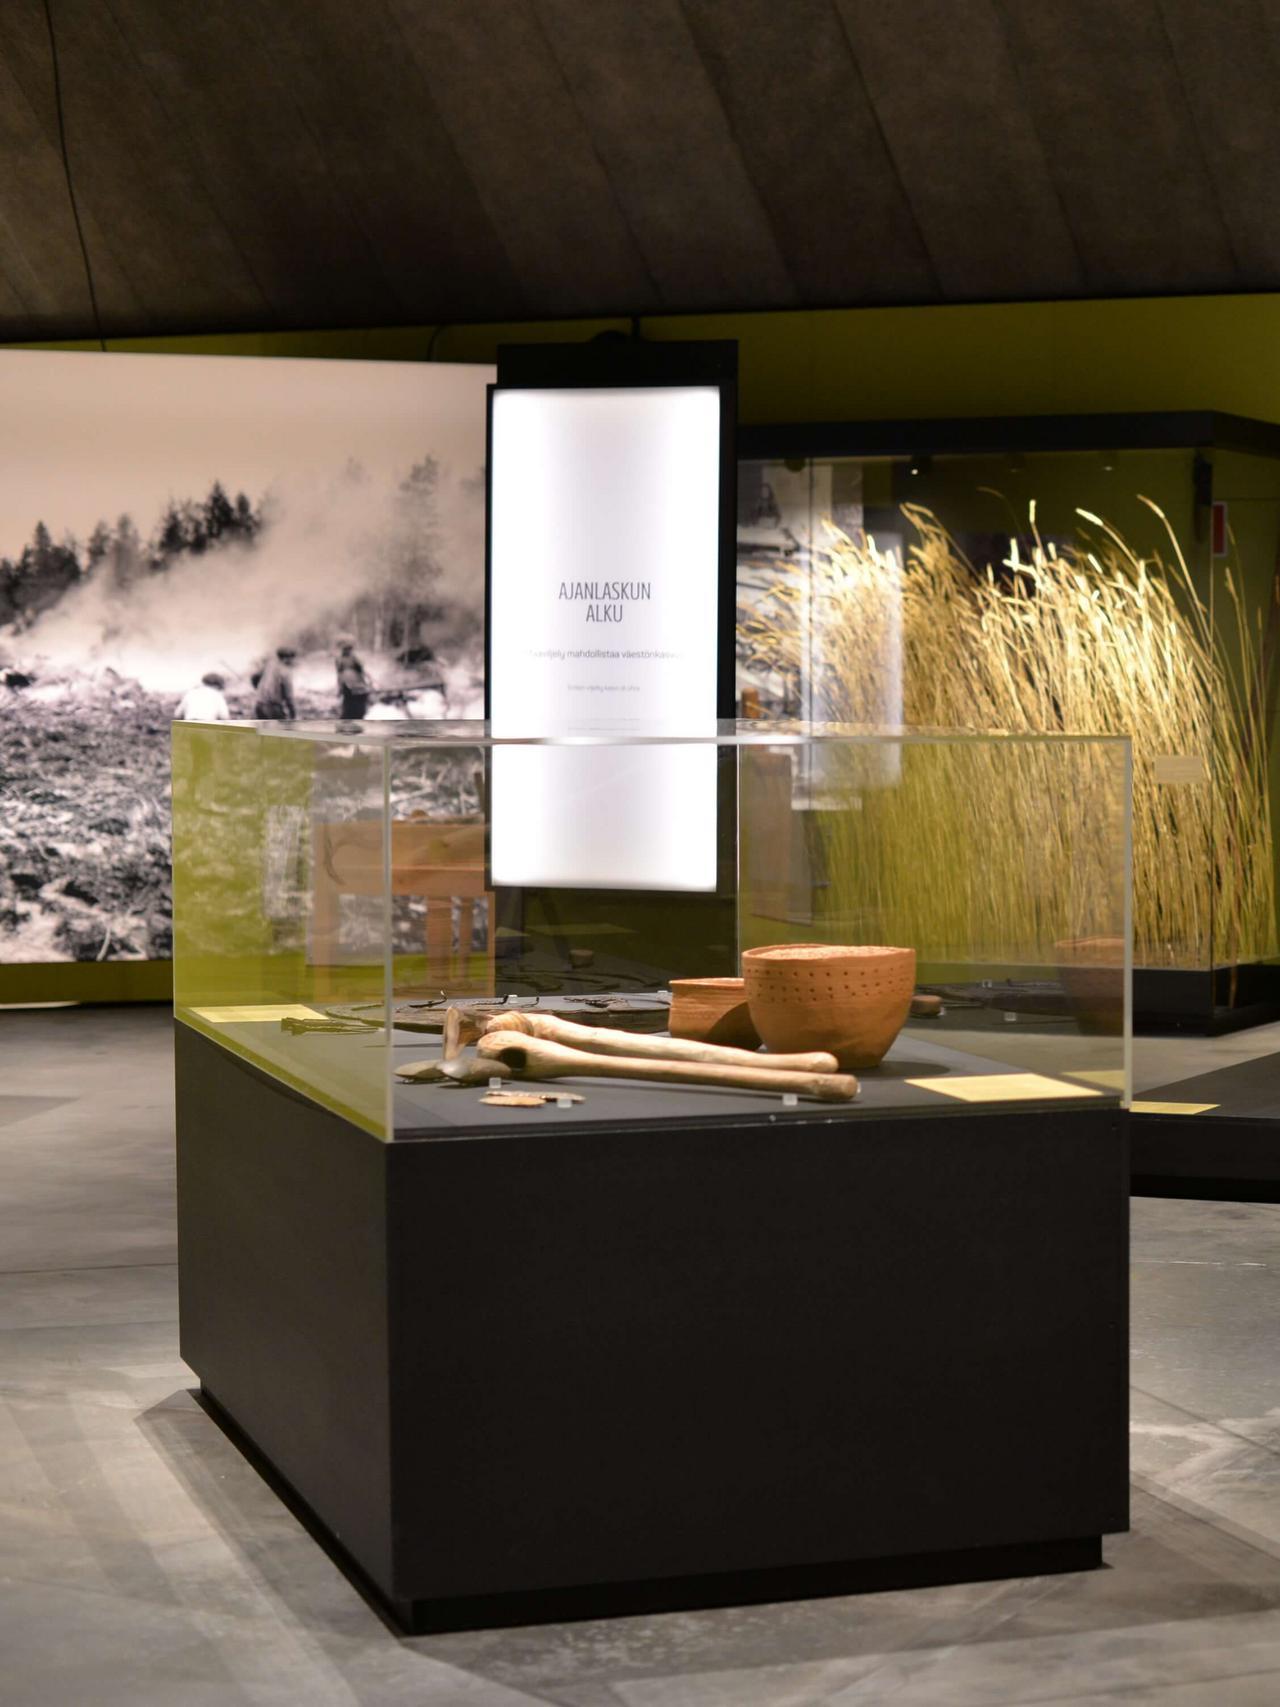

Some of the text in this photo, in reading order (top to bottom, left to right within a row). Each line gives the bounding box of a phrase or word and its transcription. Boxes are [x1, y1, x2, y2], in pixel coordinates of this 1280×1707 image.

[558, 581, 652, 601] AJANLASKUN
[585, 603, 624, 623] ALKU
[567, 648, 620, 659] mahdollistaa
